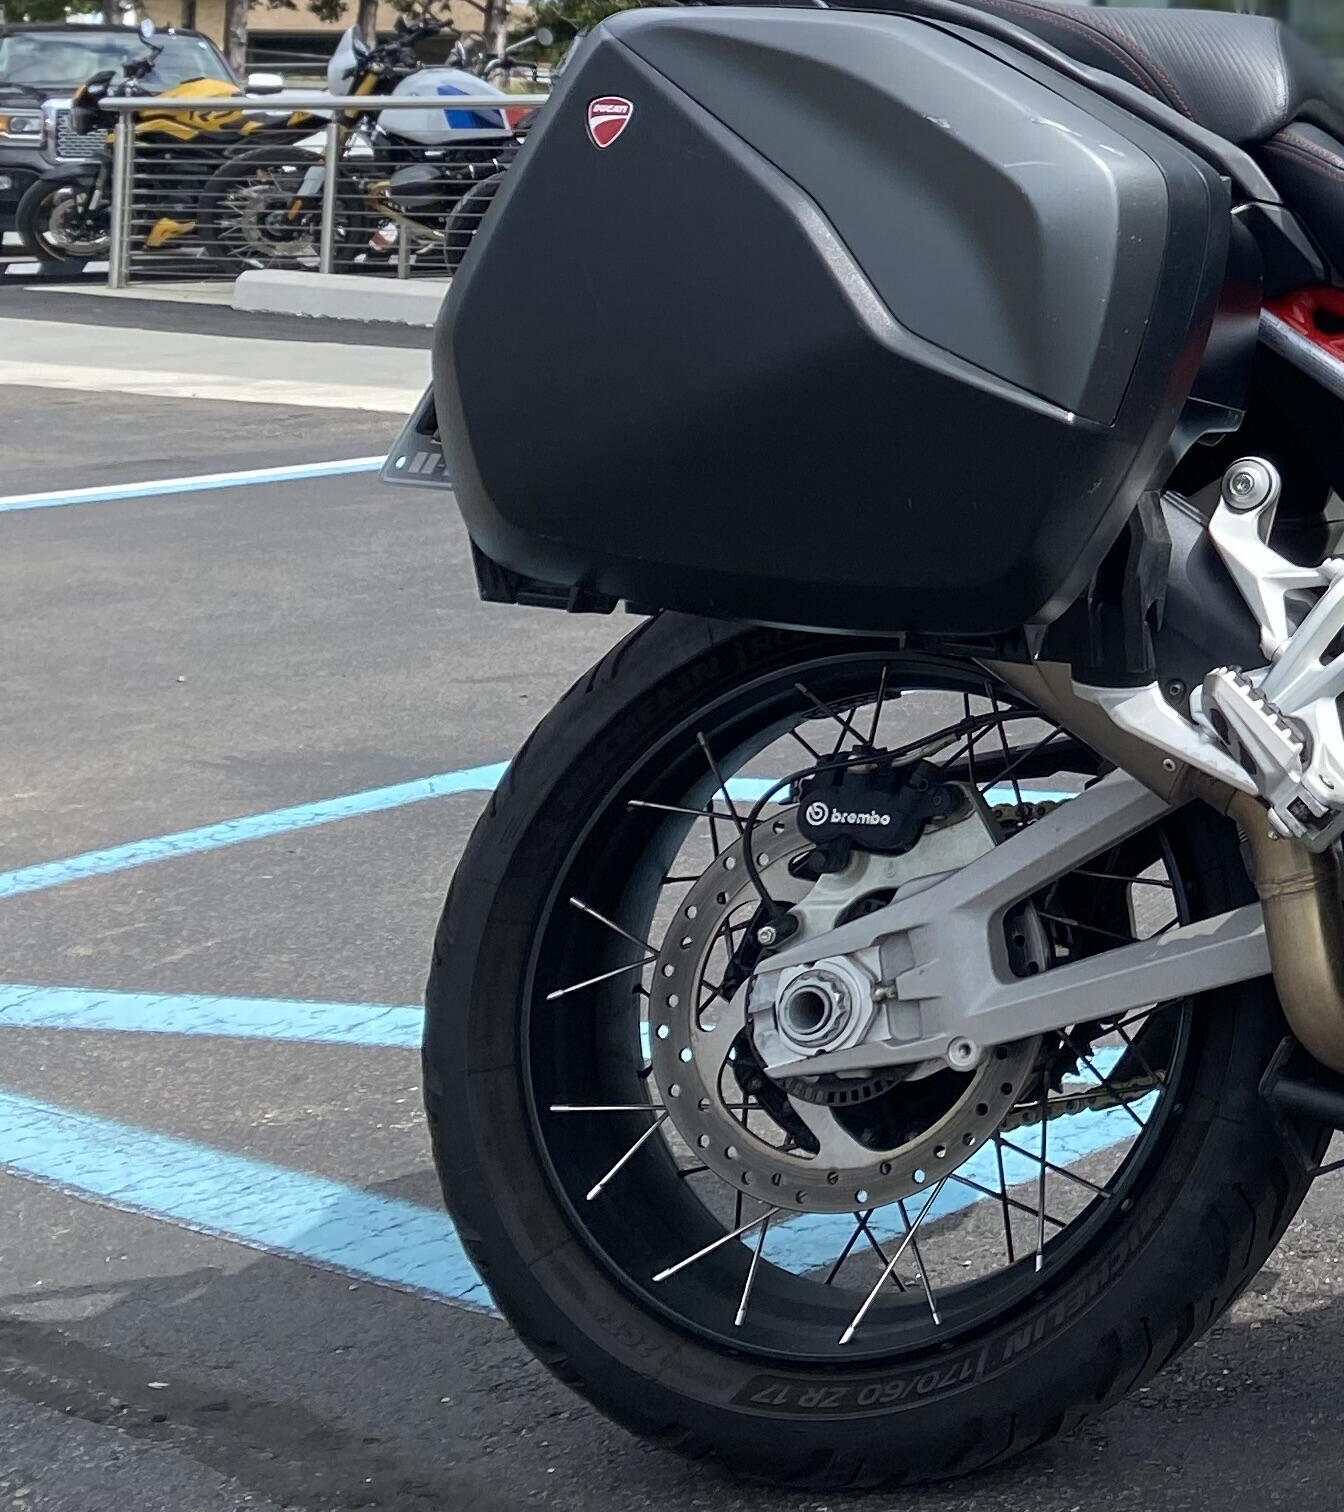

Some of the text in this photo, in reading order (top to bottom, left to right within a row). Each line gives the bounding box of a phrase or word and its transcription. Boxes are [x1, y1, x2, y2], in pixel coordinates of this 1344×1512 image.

[593, 104, 629, 114] DUCATI
[831, 808, 891, 825] brembo
[856, 1358, 972, 1406] 170/60
[750, 1384, 789, 1405] 17
[797, 1386, 842, 1408] ZR
